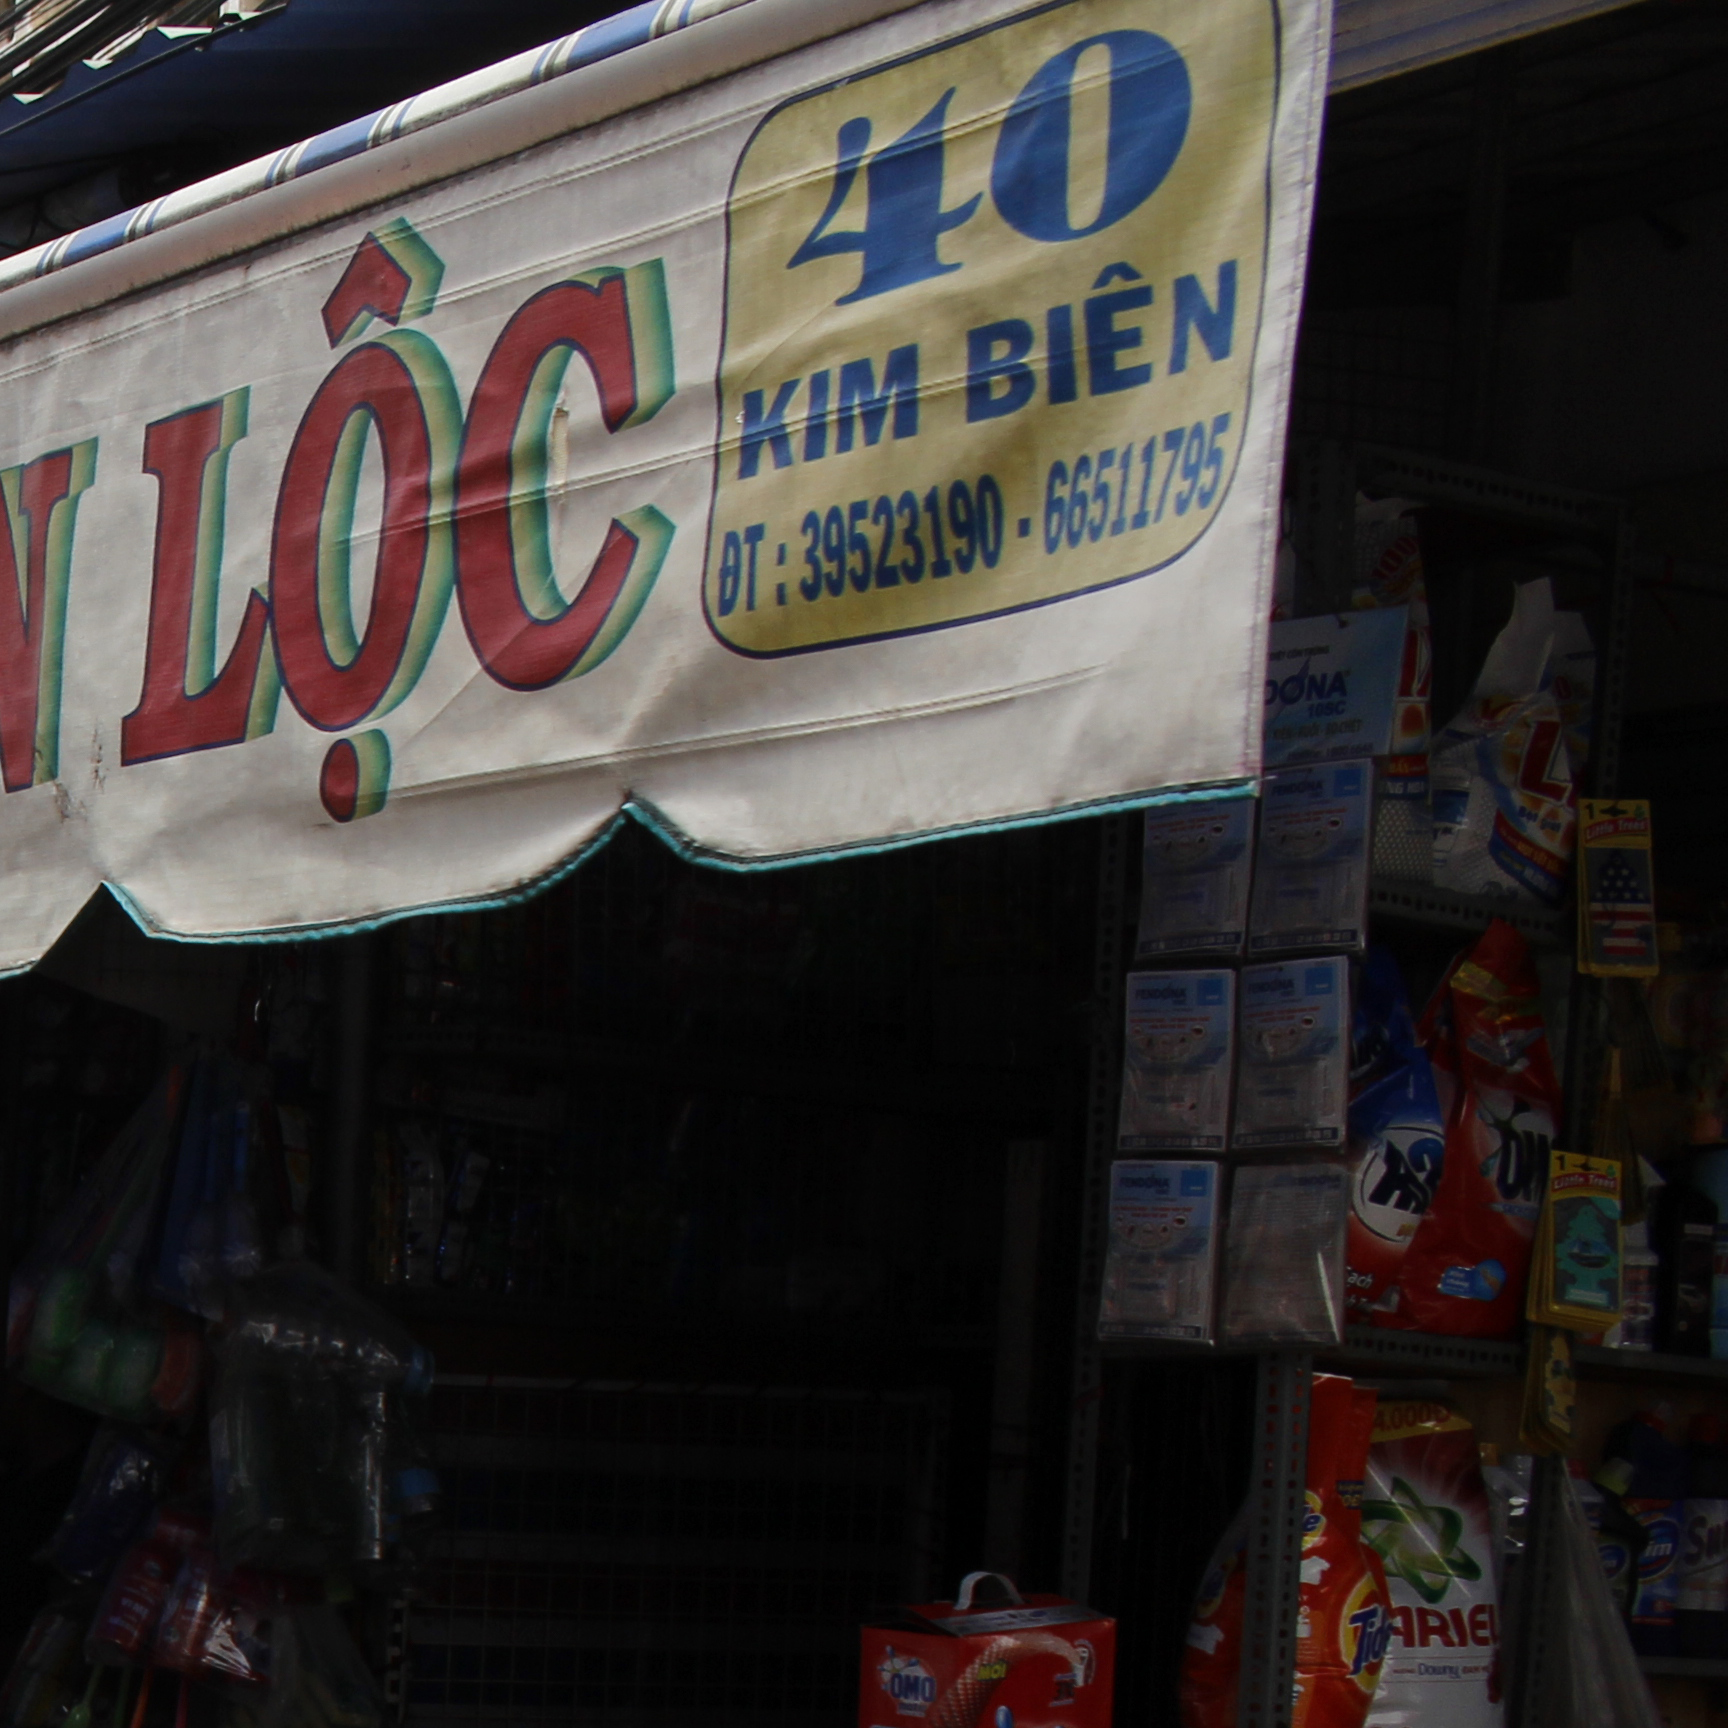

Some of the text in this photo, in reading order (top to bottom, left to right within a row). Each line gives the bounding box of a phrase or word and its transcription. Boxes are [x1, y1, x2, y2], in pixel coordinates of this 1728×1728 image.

[785, 27, 1193, 308] 40
[739, 259, 1239, 481] KIM BIÊN
[119, 216, 675, 824] LỘC
[796, 476, 1004, 605] 39523190
[1041, 409, 1231, 557] 66511795
[890, 1669, 936, 1703] OMO
[1417, 1662, 1461, 1680] Downy
